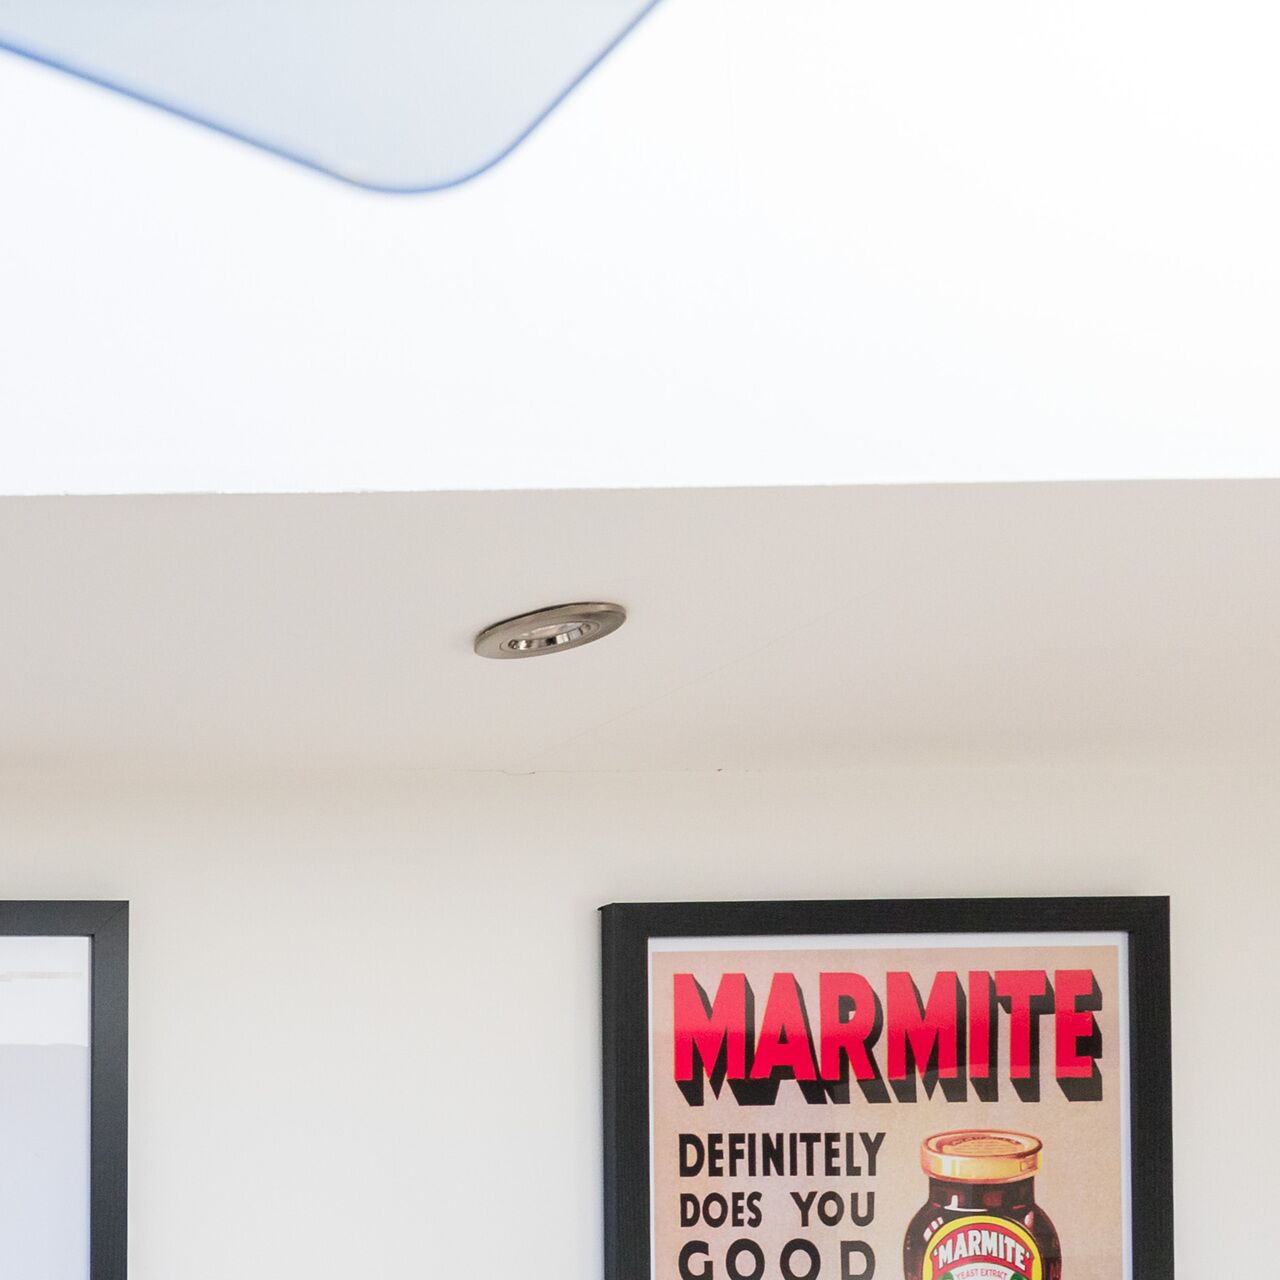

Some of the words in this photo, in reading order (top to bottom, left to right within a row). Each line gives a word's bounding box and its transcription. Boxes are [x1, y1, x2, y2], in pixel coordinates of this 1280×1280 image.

[673, 969, 1101, 1100] MARMITE
[678, 1132, 886, 1178] DEFINITELY
[680, 1192, 763, 1228] DOES
[790, 1191, 875, 1228] YOU
[956, 1268, 978, 1280] YEAST
[980, 1268, 1008, 1280] EXTRACT
